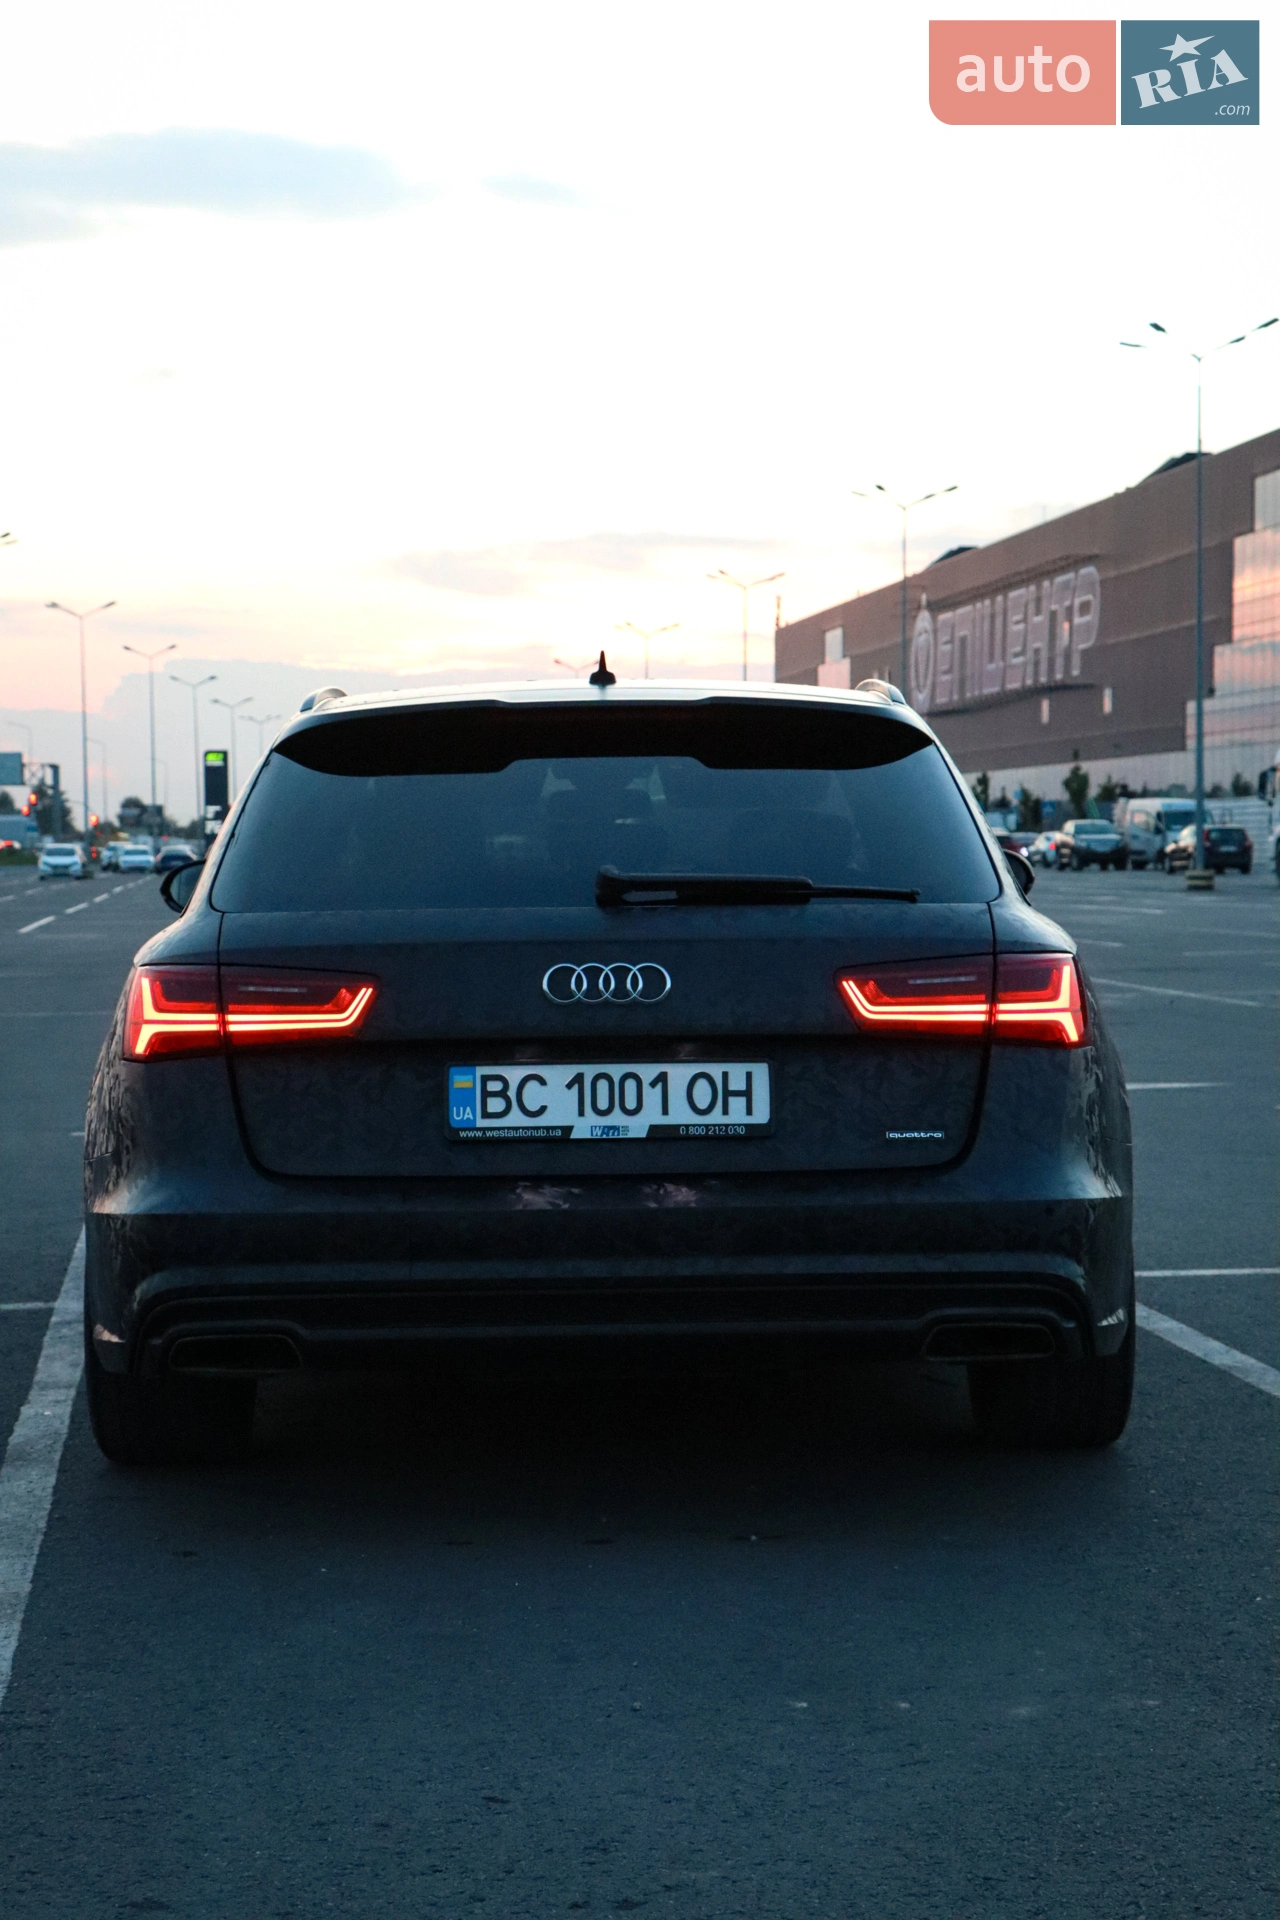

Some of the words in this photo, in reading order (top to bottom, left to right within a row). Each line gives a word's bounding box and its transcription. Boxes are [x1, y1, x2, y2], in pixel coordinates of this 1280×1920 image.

[480, 1073, 548, 1119] BC
[565, 1071, 669, 1117] 1001
[686, 1071, 753, 1116] OH
[453, 1106, 474, 1120] UA
[680, 1126, 686, 1135] 0
[689, 1126, 706, 1135] 800
[708, 1126, 727, 1135] 212
[728, 1125, 746, 1135] 030
